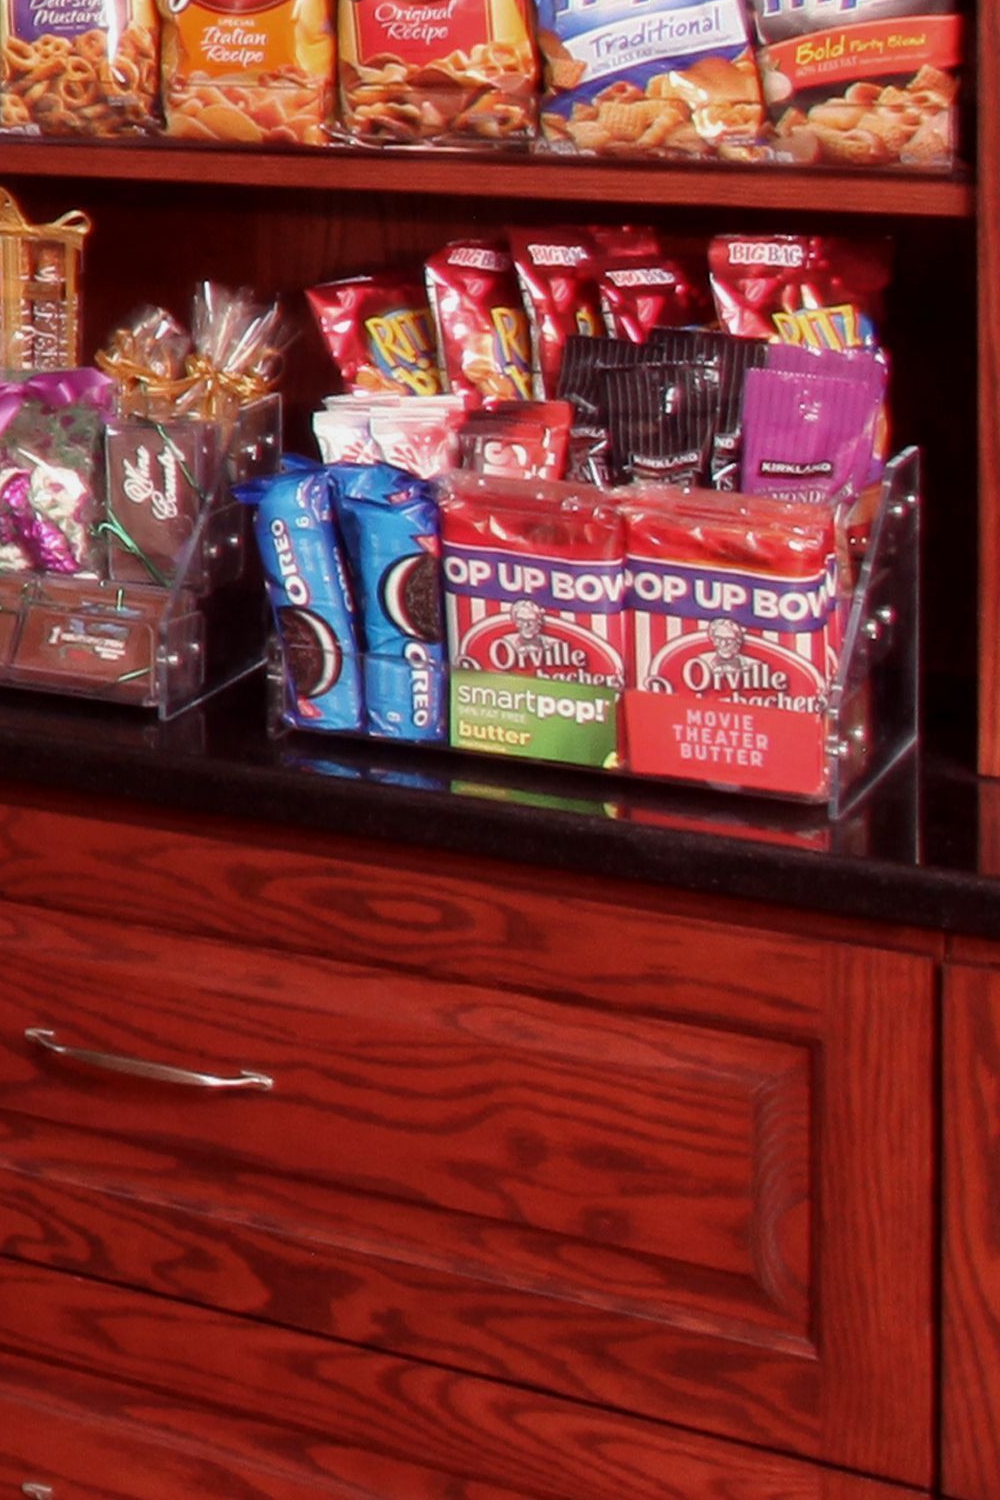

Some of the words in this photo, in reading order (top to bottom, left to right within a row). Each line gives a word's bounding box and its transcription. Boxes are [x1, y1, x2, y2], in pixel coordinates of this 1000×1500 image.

[375, 0, 457, 27] Original
[202, 26, 267, 47] Italian
[382, 21, 448, 45] Recipe
[590, 6, 721, 59] Traditional
[200, 44, 264, 67] Recipe
[795, 34, 846, 66] Bold
[448, 248, 478, 267] BIG
[480, 250, 504, 271] BA
[528, 244, 563, 265] BIG
[728, 242, 766, 265] BIG
[767, 243, 803, 267] BAG
[365, 306, 438, 368] RIT
[632, 451, 699, 469] KIRKLAND
[760, 462, 832, 474] KIRKLAND
[270, 518, 309, 607] OREO
[443, 555, 491, 587] OP
[497, 562, 546, 594] UP
[550, 569, 624, 603] BOW
[695, 578, 747, 612] UP
[753, 587, 827, 621] BOW
[489, 637, 587, 670] Orville
[404, 641, 431, 728] OREO
[682, 658, 788, 692] Orville
[458, 720, 531, 745] butter
[686, 709, 754, 731] MOVIE
[672, 724, 769, 751] THEATER
[680, 742, 764, 767] BUTTER
